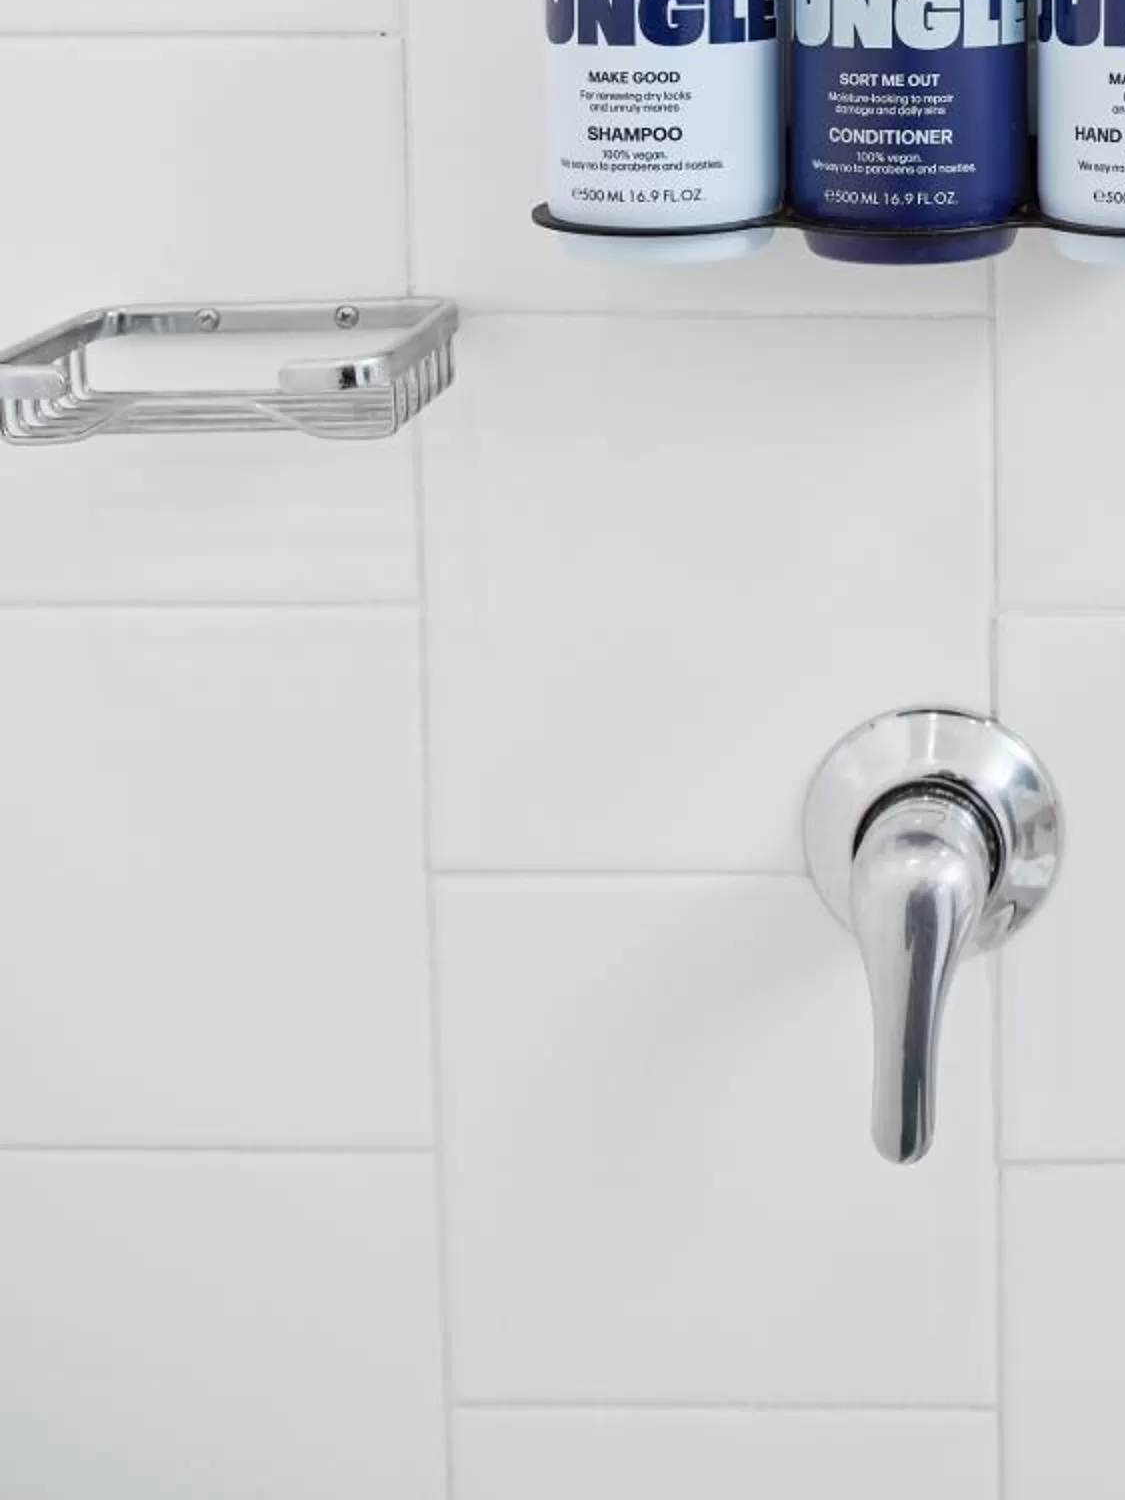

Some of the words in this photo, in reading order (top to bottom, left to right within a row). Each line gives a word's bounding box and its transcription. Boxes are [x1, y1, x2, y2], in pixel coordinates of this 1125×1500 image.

[588, 72, 628, 84] MAKE
[633, 72, 680, 84] GOOD
[840, 73, 879, 86] SORT
[882, 74, 905, 87] ME
[908, 73, 940, 87] OUT
[923, 94, 954, 104] repair
[877, 105, 896, 114] and
[588, 125, 683, 142] SHAMPOO
[829, 127, 953, 145] CONDITIONER
[1075, 125, 1122, 143] HAND
[856, 152, 886, 162] 100%
[662, 160, 683, 170] and
[918, 163, 937, 173] and
[607, 190, 625, 202] ML
[630, 190, 659, 203] 16.9
[861, 191, 880, 205] ML
[884, 192, 914, 205] 16.9
